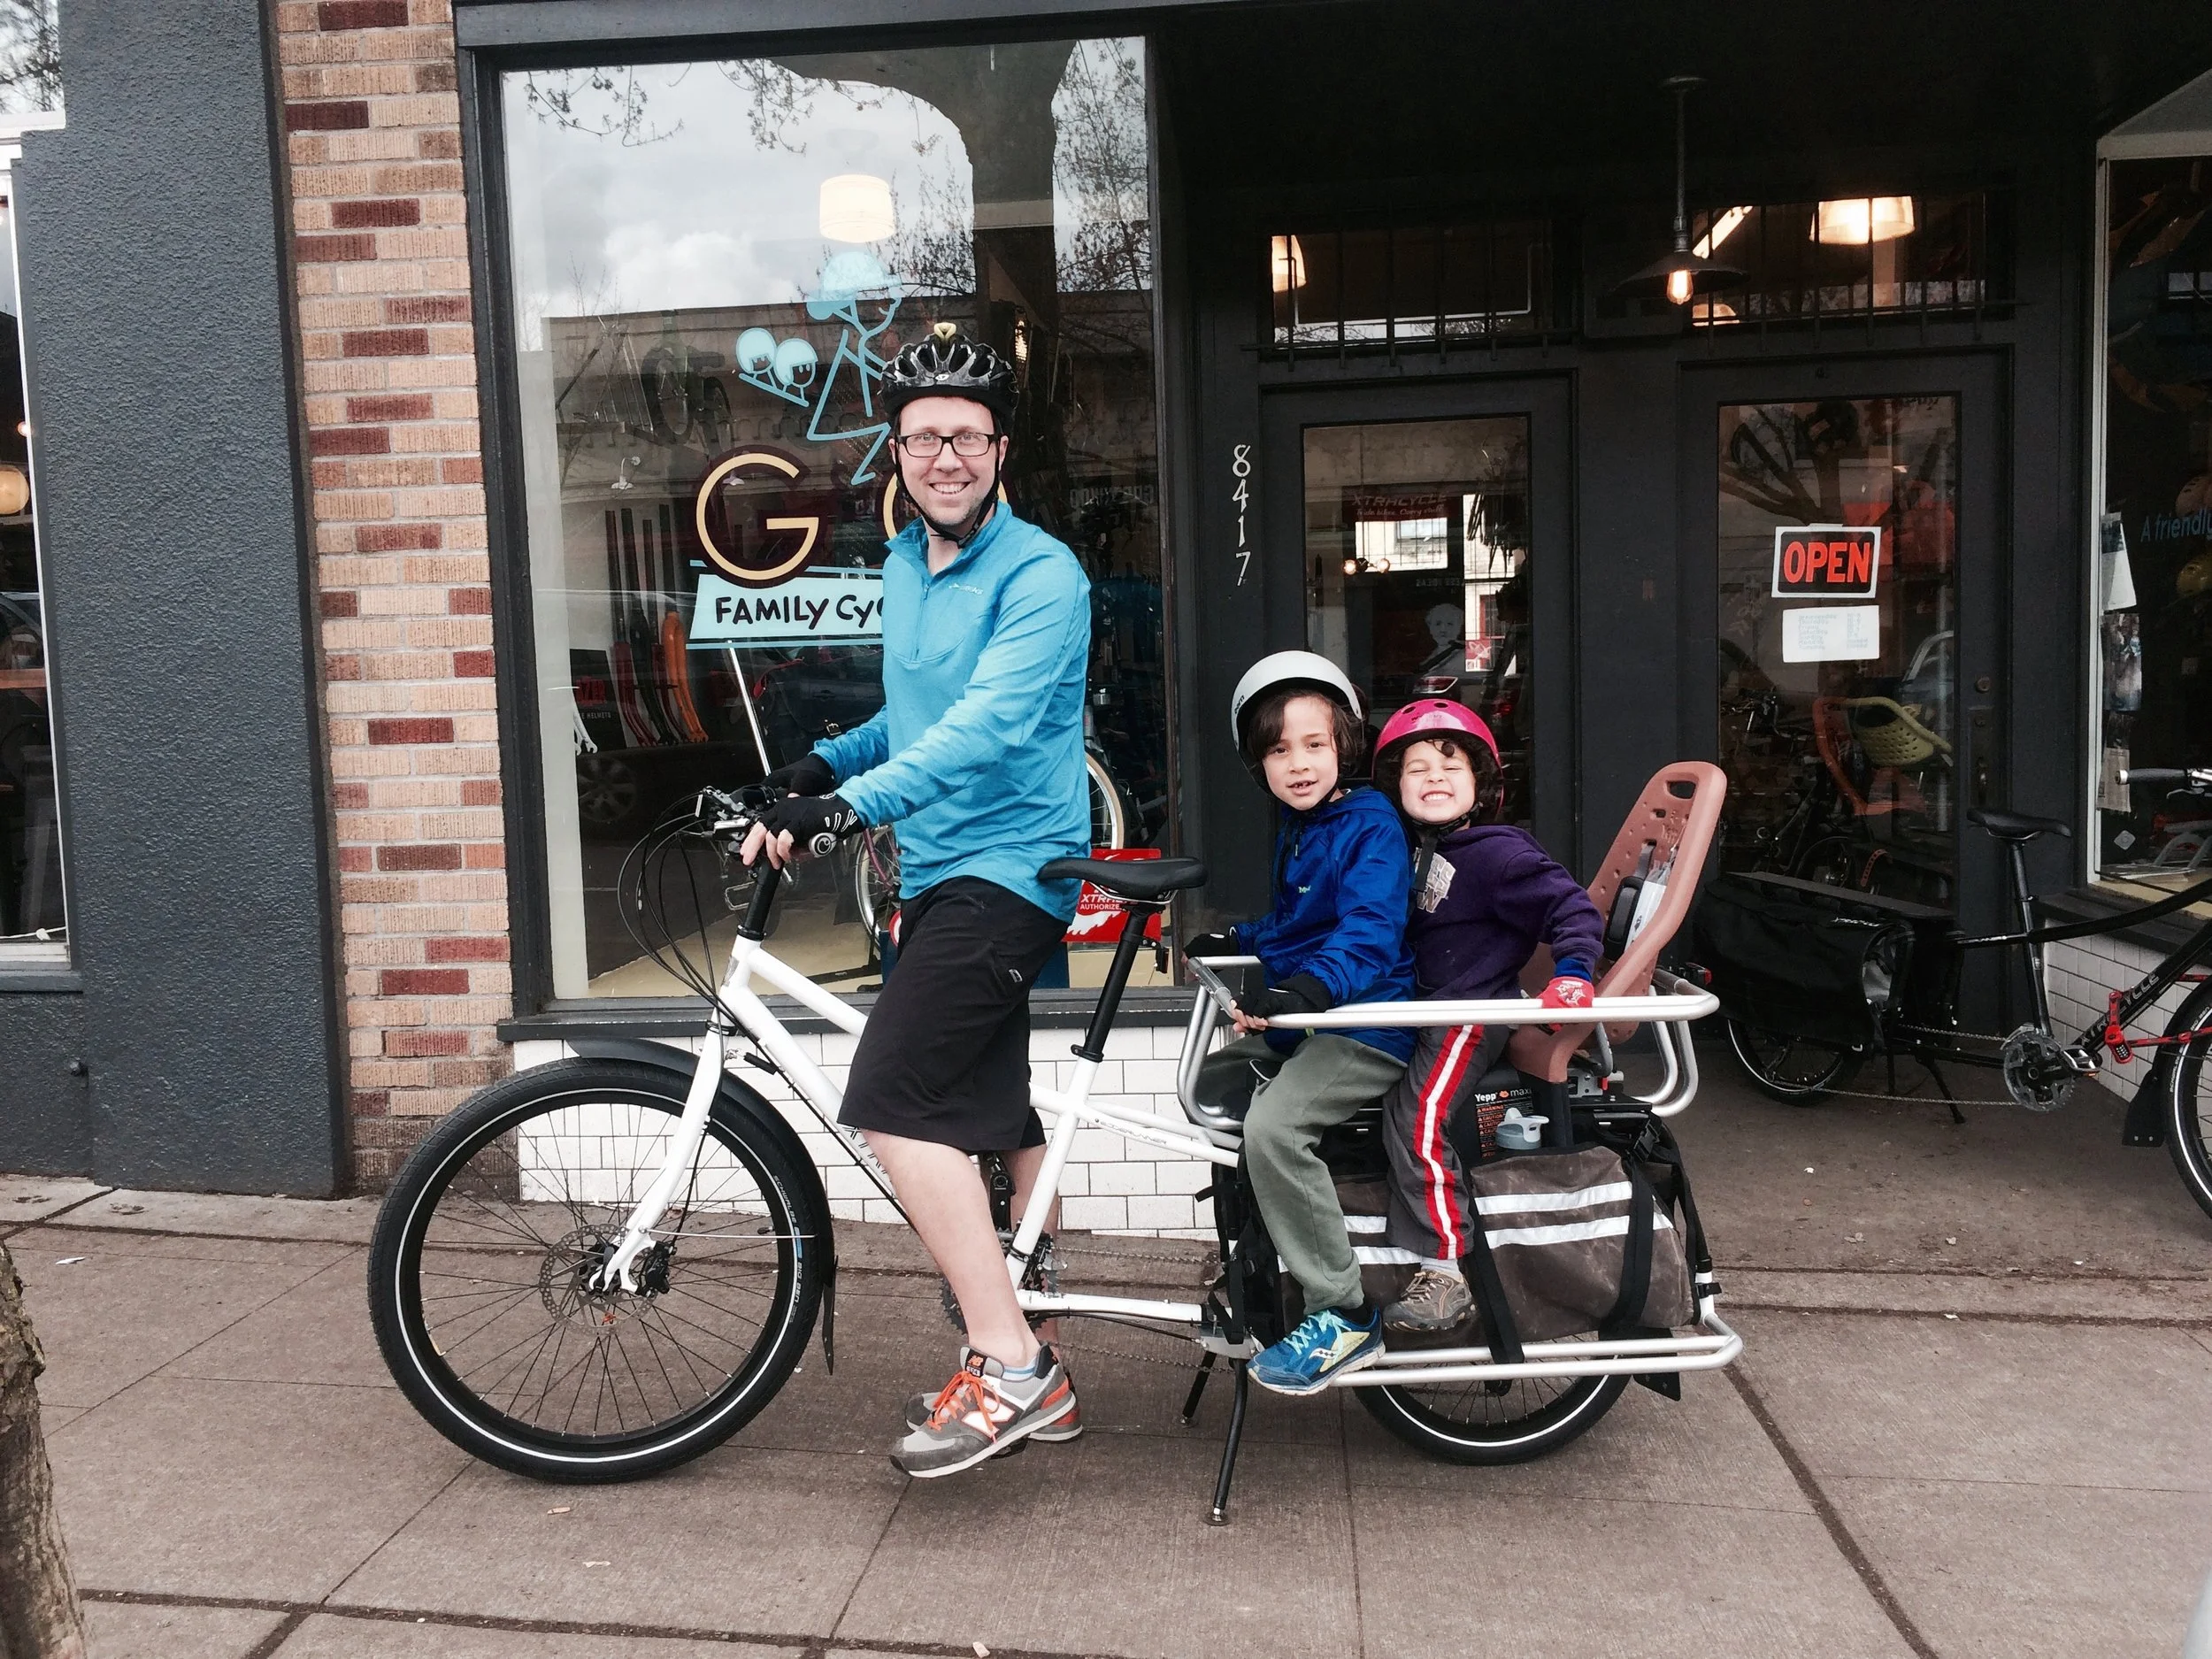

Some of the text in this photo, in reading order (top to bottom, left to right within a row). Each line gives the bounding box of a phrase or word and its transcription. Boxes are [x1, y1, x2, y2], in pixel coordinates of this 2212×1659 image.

[1233, 444, 1251, 586] 8417
[2140, 515, 2151, 542] A
[1784, 541, 1870, 583] OPEN
[716, 595, 829, 630] FAMILY
[1474, 1088, 1532, 1102] Yepp maxi
[773, 1175, 797, 1224] SCHWALBE
